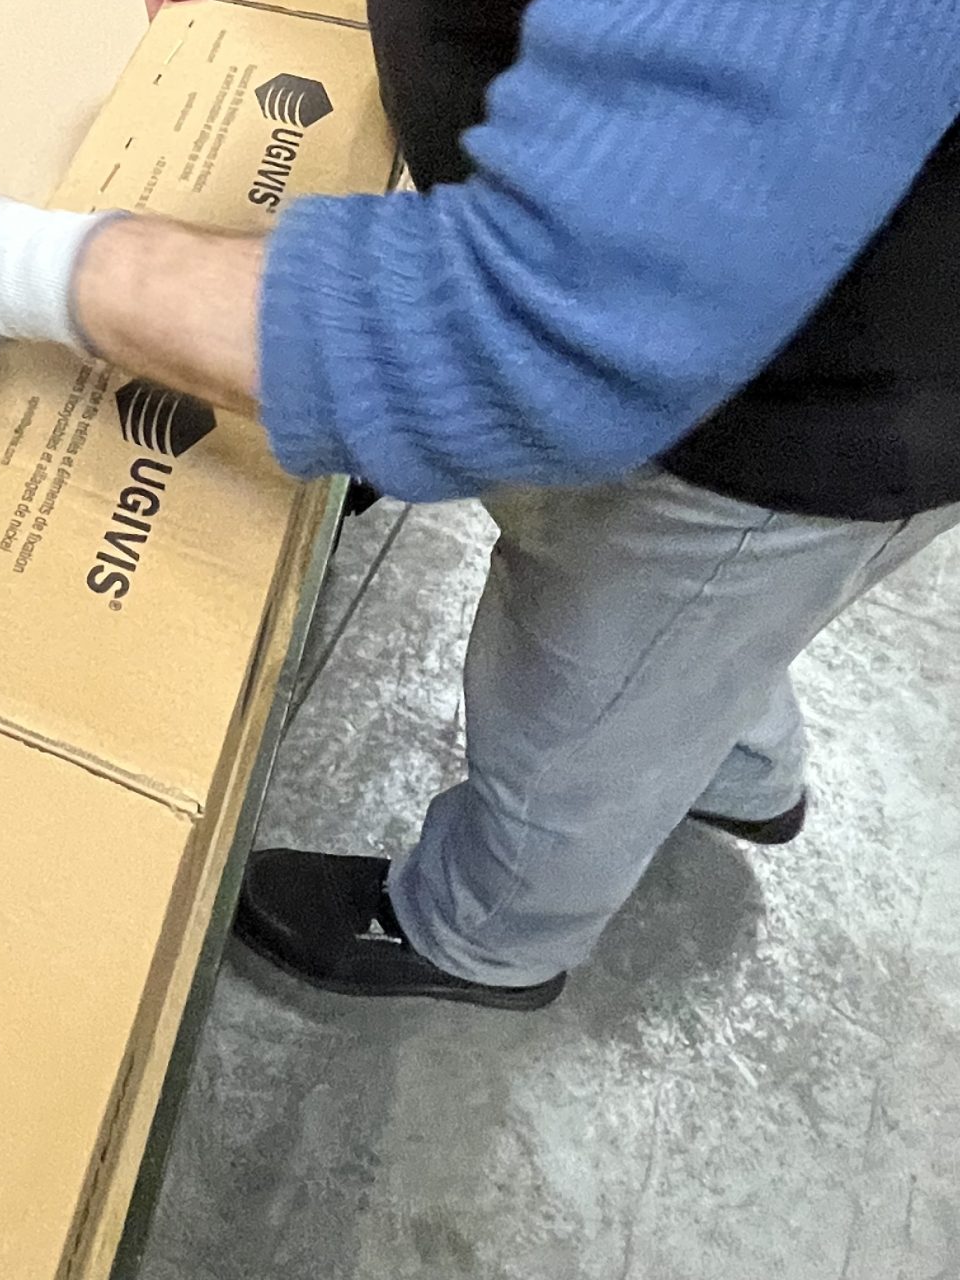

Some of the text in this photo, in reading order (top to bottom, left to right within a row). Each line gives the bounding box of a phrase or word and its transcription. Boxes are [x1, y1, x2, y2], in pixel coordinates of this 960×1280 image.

[14, 503, 32, 518] de
[31, 516, 49, 532] de
[13, 532, 43, 574] fixation
